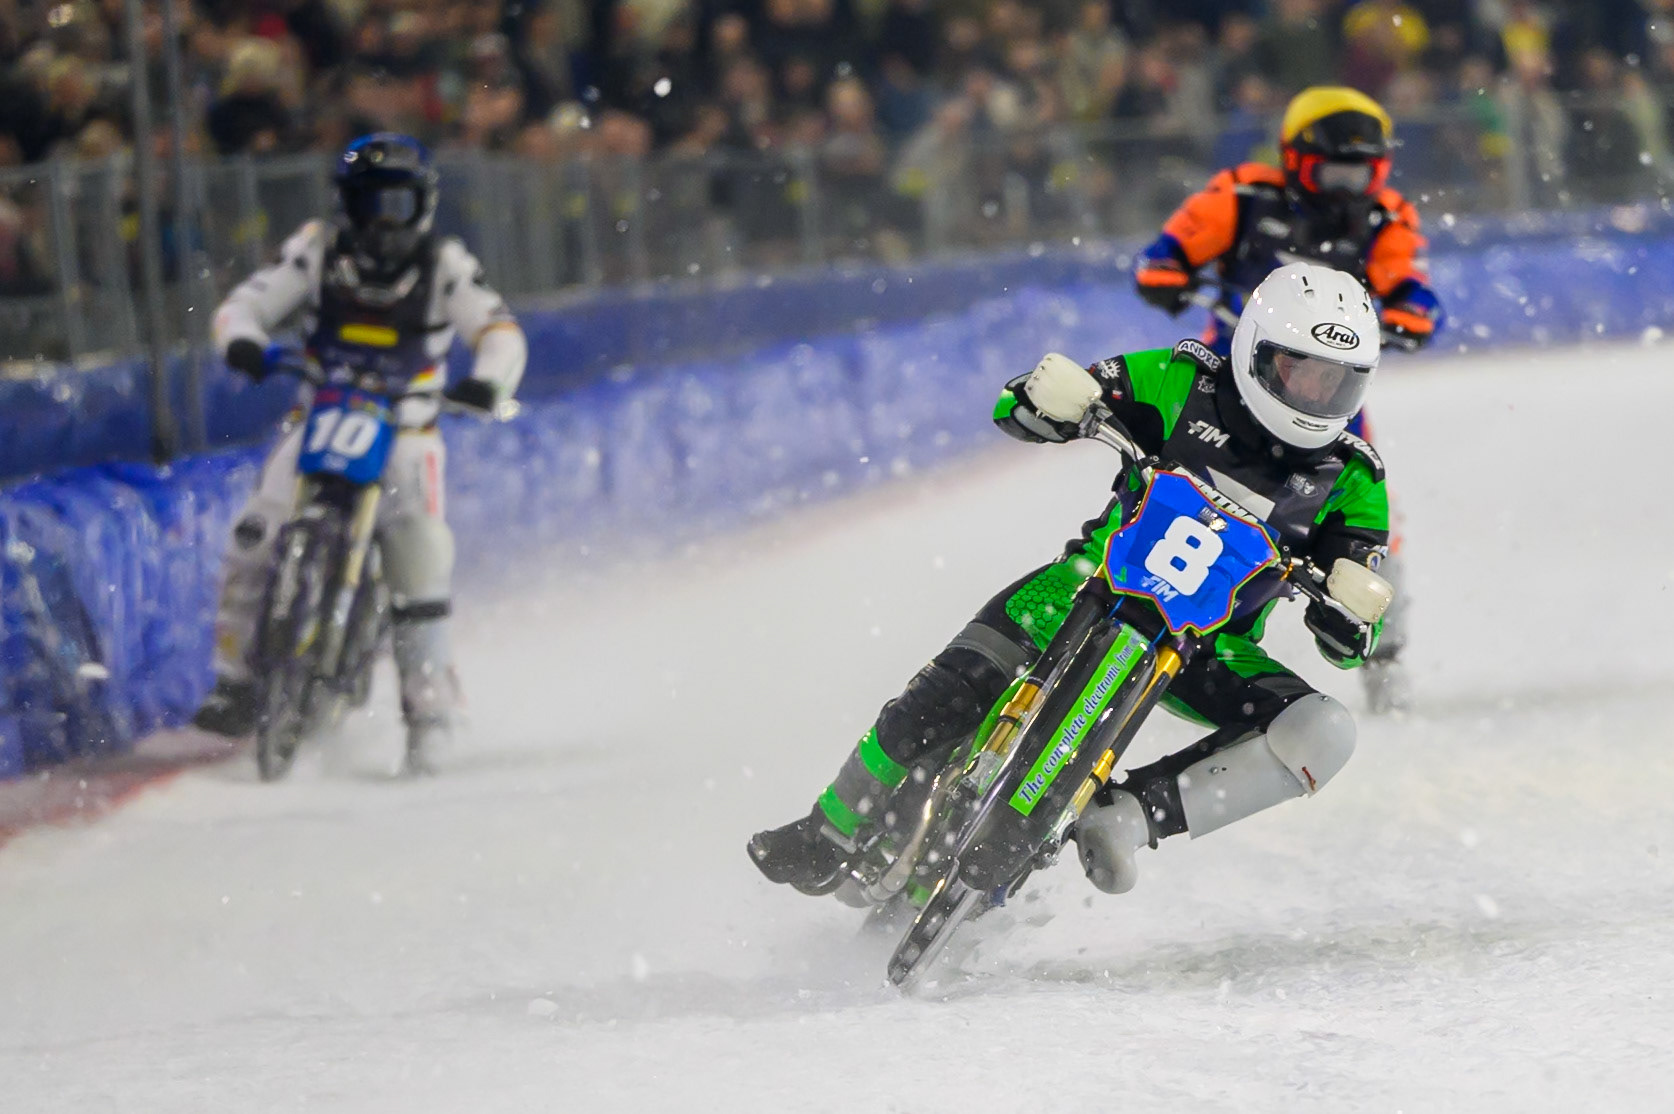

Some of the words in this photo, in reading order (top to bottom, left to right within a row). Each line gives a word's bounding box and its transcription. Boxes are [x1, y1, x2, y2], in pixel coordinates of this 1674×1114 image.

[1315, 325, 1355, 345] Arai
[1180, 342, 1218, 370] ANDRE
[308, 407, 379, 458] 10
[1188, 420, 1230, 448] FIM
[1144, 515, 1223, 596] 8
[1141, 575, 1179, 602] FIM
[1018, 771, 1045, 803] The
[1044, 713, 1086, 774] complete
[1084, 664, 1121, 715] electronic
[1115, 645, 1134, 669] from
